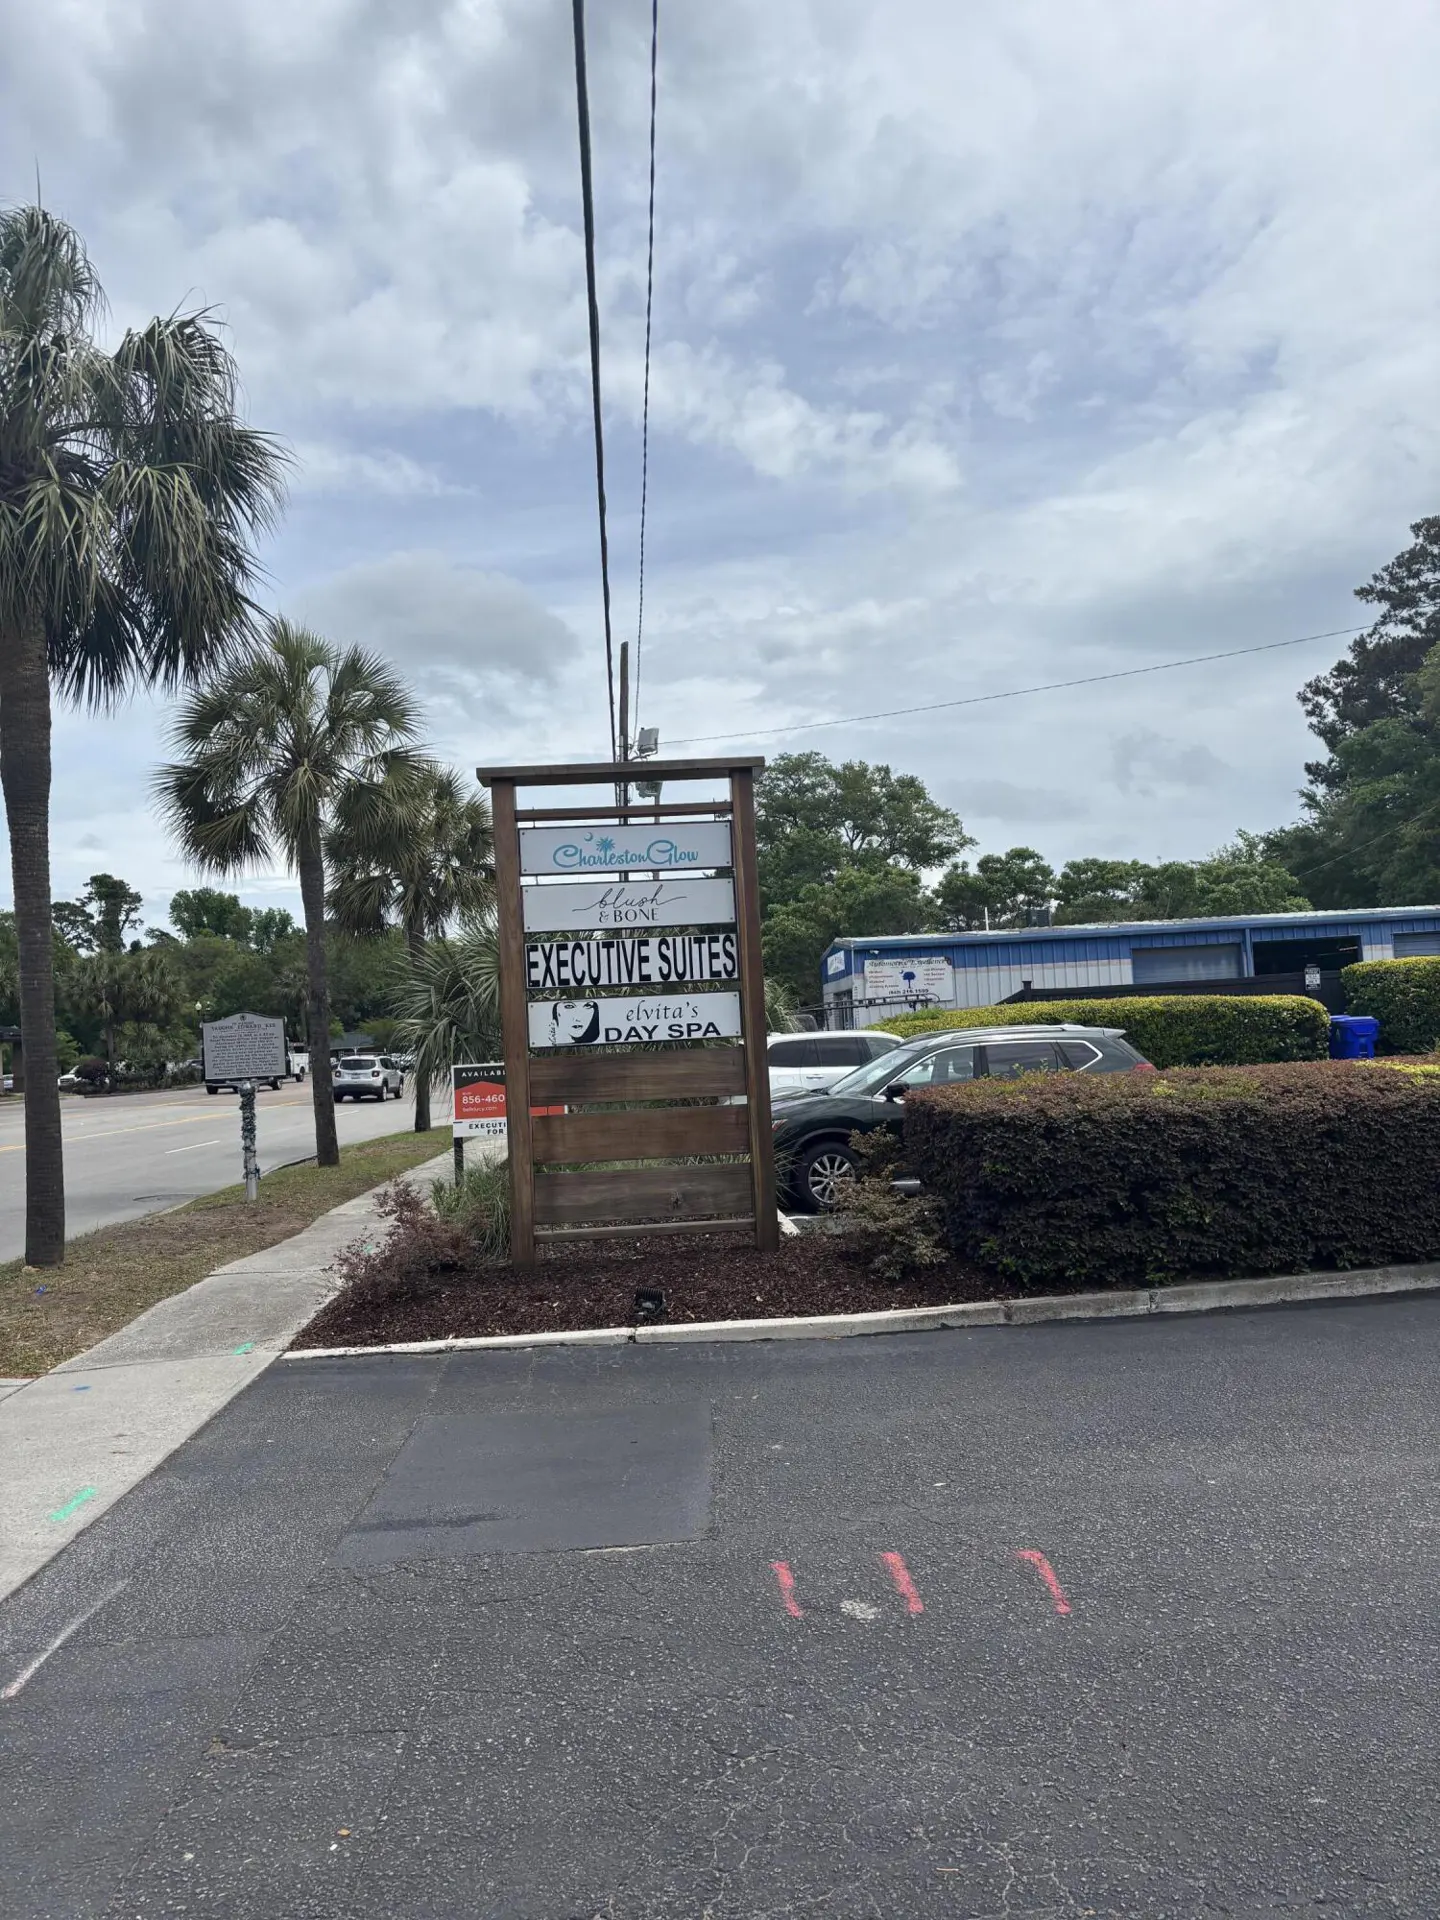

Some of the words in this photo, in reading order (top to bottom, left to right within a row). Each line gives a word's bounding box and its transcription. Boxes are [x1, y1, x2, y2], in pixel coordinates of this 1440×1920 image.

[572, 884, 687, 912] blush
[598, 910, 609, 923] &
[613, 907, 660, 923] BONE
[526, 939, 651, 987] EXECUTIVE
[658, 934, 736, 980] SUITES
[626, 1000, 699, 1022] elvita's
[604, 1025, 659, 1042] DAY
[667, 1022, 721, 1039] SPA
[462, 1094, 505, 1104] 856-460
